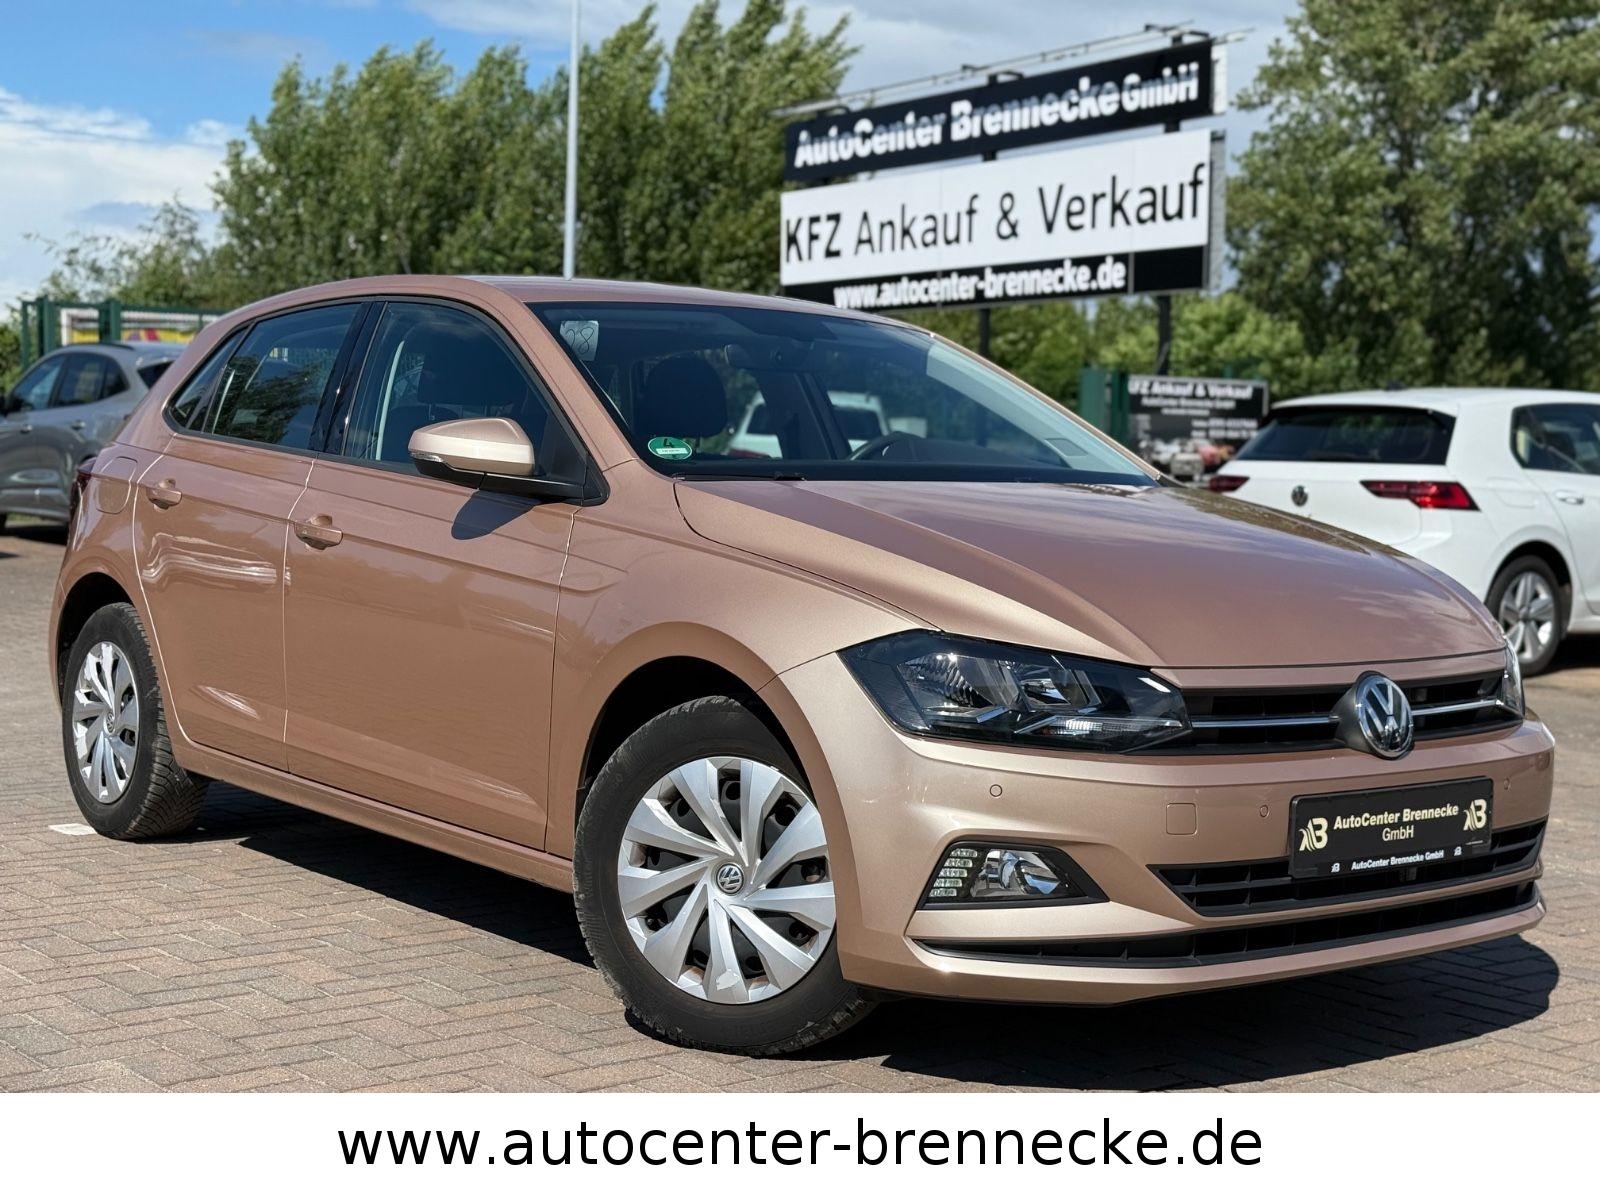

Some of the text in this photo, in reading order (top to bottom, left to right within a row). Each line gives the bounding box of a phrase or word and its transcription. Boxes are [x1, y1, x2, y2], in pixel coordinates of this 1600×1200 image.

[794, 62, 1200, 168] AutoCenter Brennecke GmbH
[785, 162, 1206, 263] KFZ Ankauf & Verkauf
[833, 255, 1127, 309] www.autocenter-brennecke.de
[1333, 803, 1460, 830] AutoCenter Brennecke
[1382, 825, 1415, 842] GmbH
[1351, 849, 1445, 871] AutoCenter Brennecke GmbH
